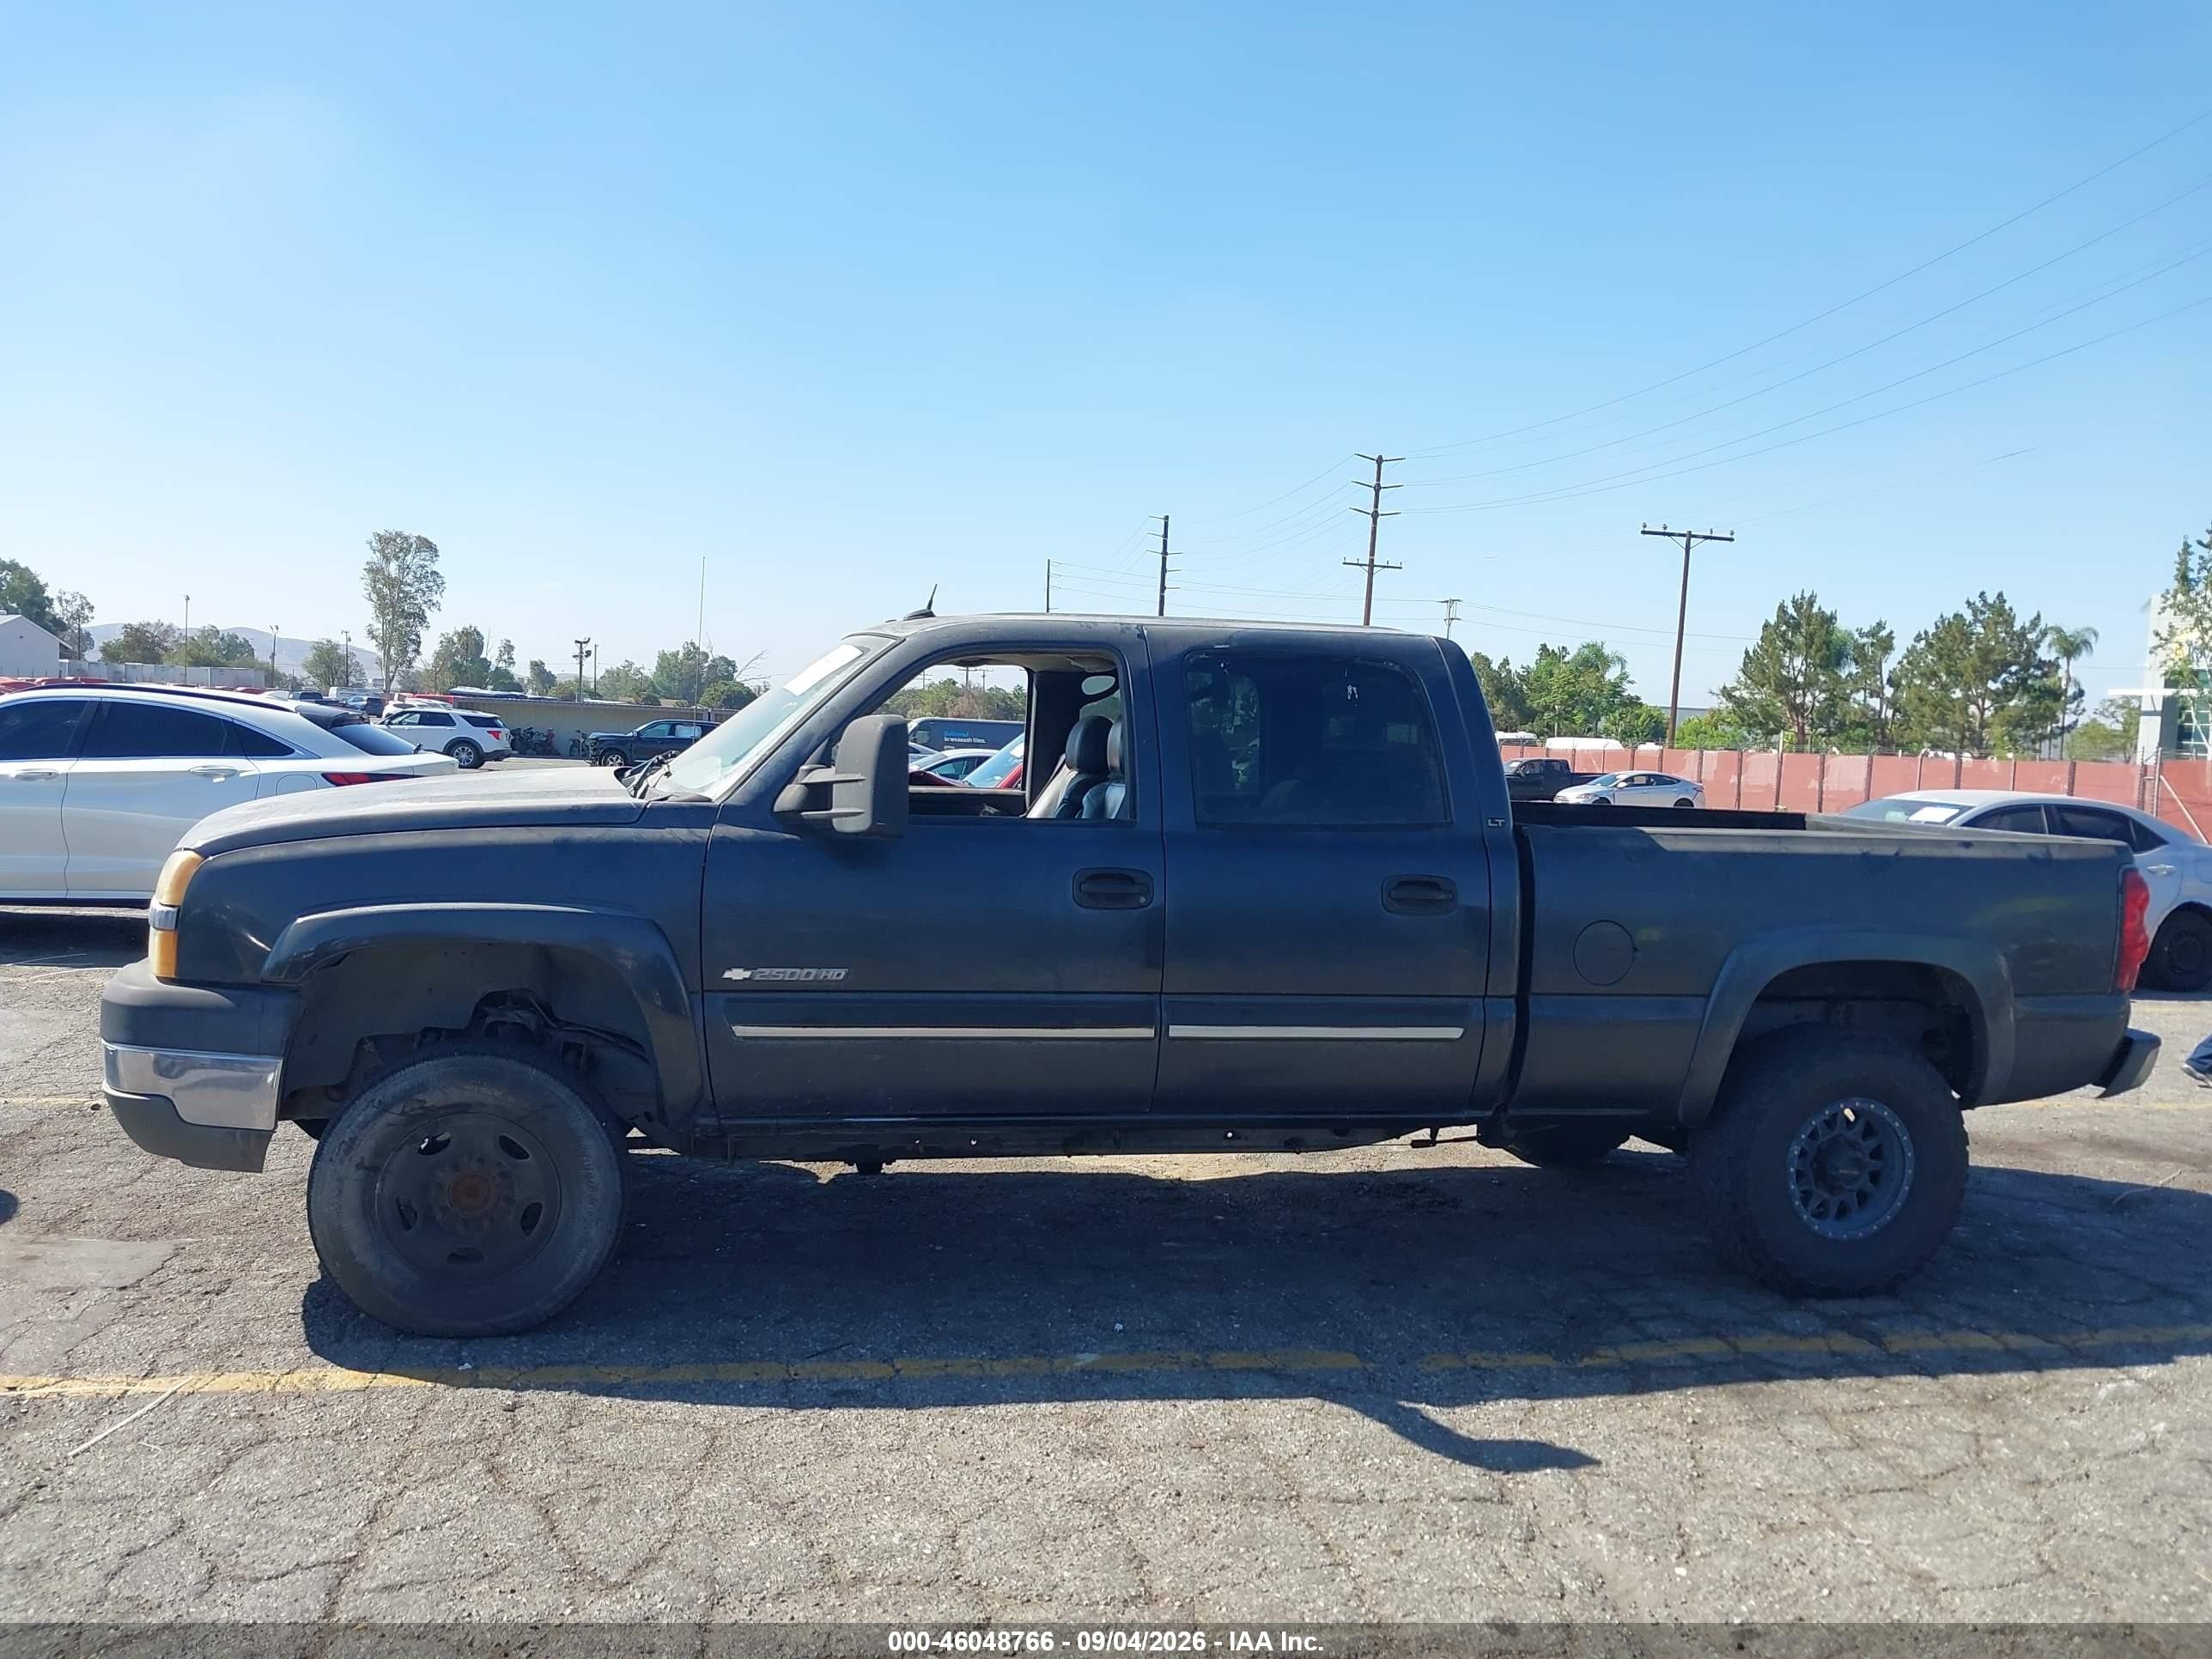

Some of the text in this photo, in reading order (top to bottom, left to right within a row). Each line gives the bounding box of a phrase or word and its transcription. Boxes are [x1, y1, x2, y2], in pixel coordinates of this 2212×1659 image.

[1487, 818, 1505, 827] LT
[752, 969, 847, 981] 2500 HD
